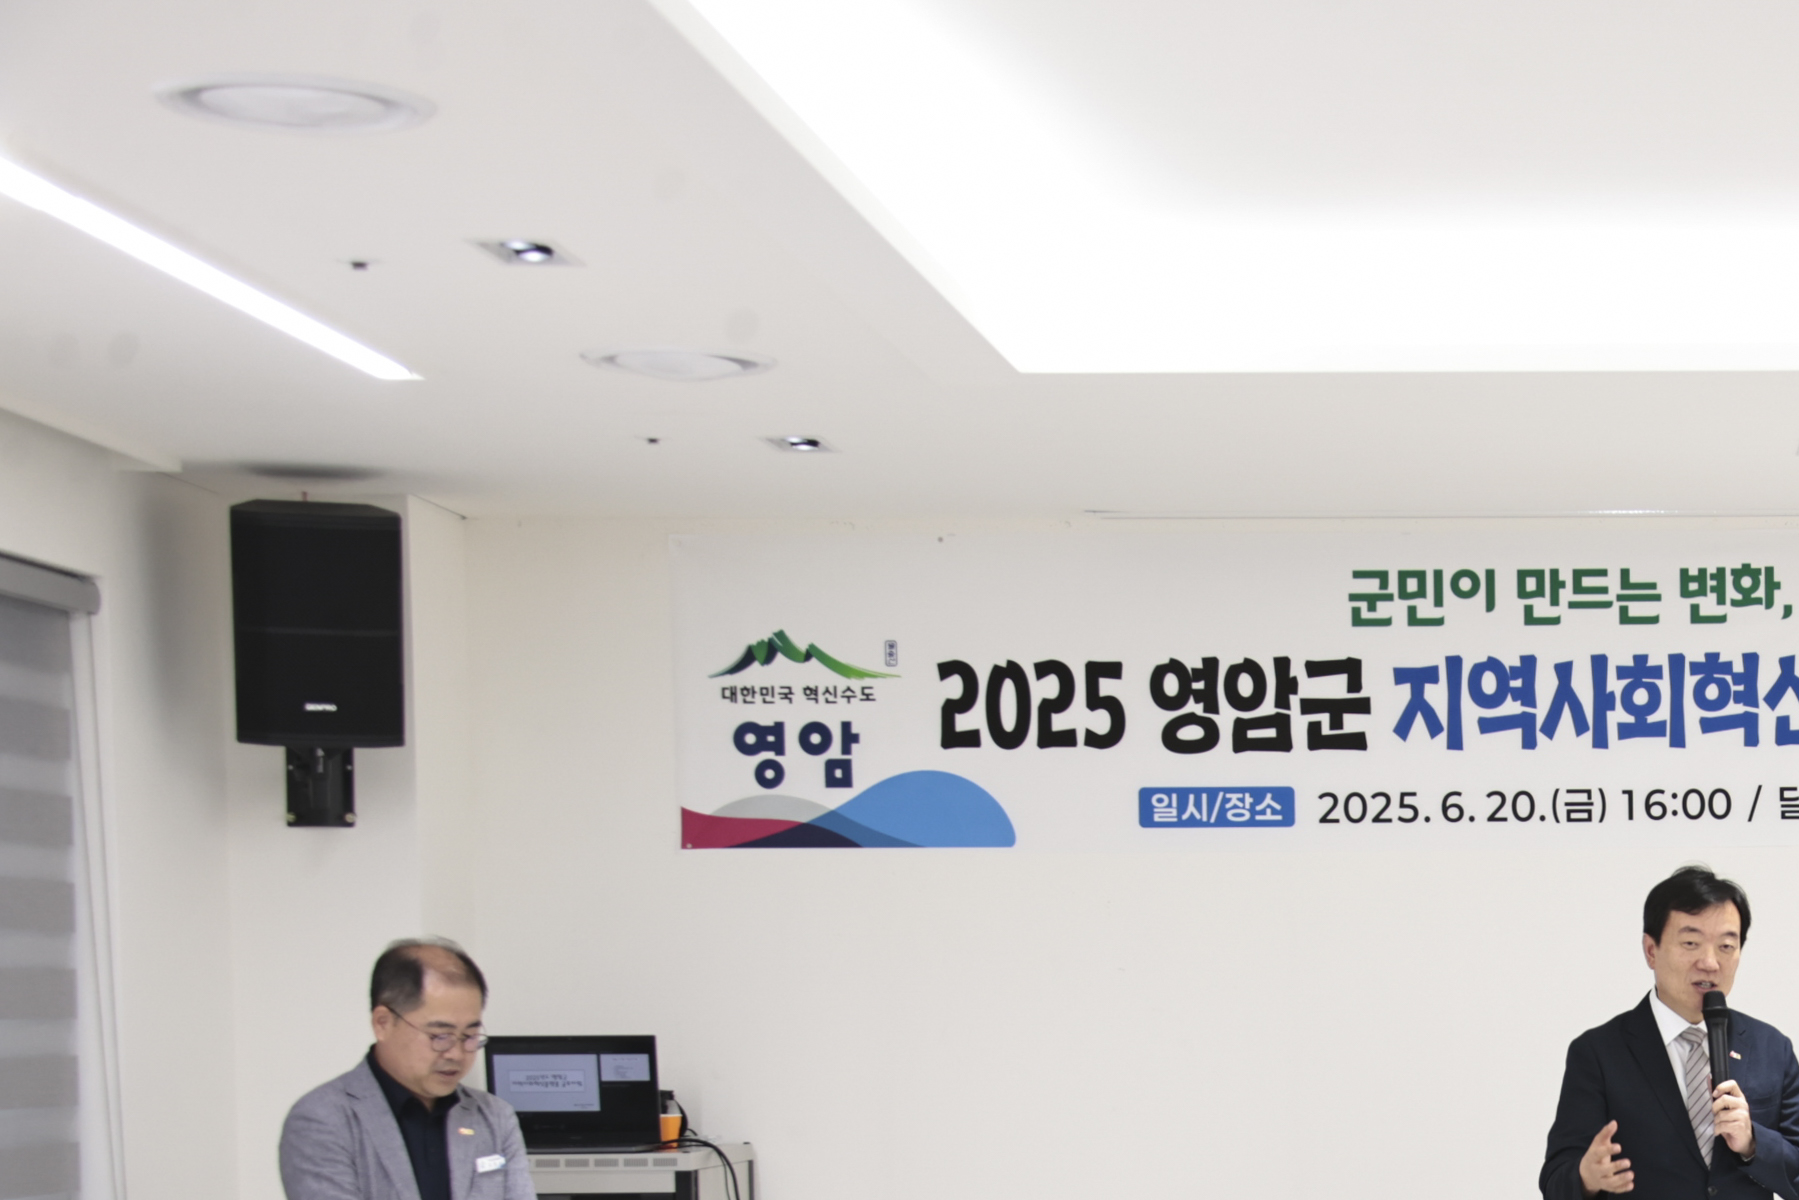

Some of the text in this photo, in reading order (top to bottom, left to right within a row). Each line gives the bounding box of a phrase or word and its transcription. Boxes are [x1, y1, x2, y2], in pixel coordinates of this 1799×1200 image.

[1348, 567, 1497, 627] 군민이
[1516, 567, 1663, 627] 만드는
[1678, 562, 1793, 625] 변화,
[720, 685, 877, 705] 대한민국 혁신수도
[936, 657, 1127, 751] 2025
[1148, 655, 1372, 755] 영암군
[732, 720, 861, 789] 영암
[1150, 792, 1283, 824] 일시/장소
[1621, 787, 1733, 822] 16:00
